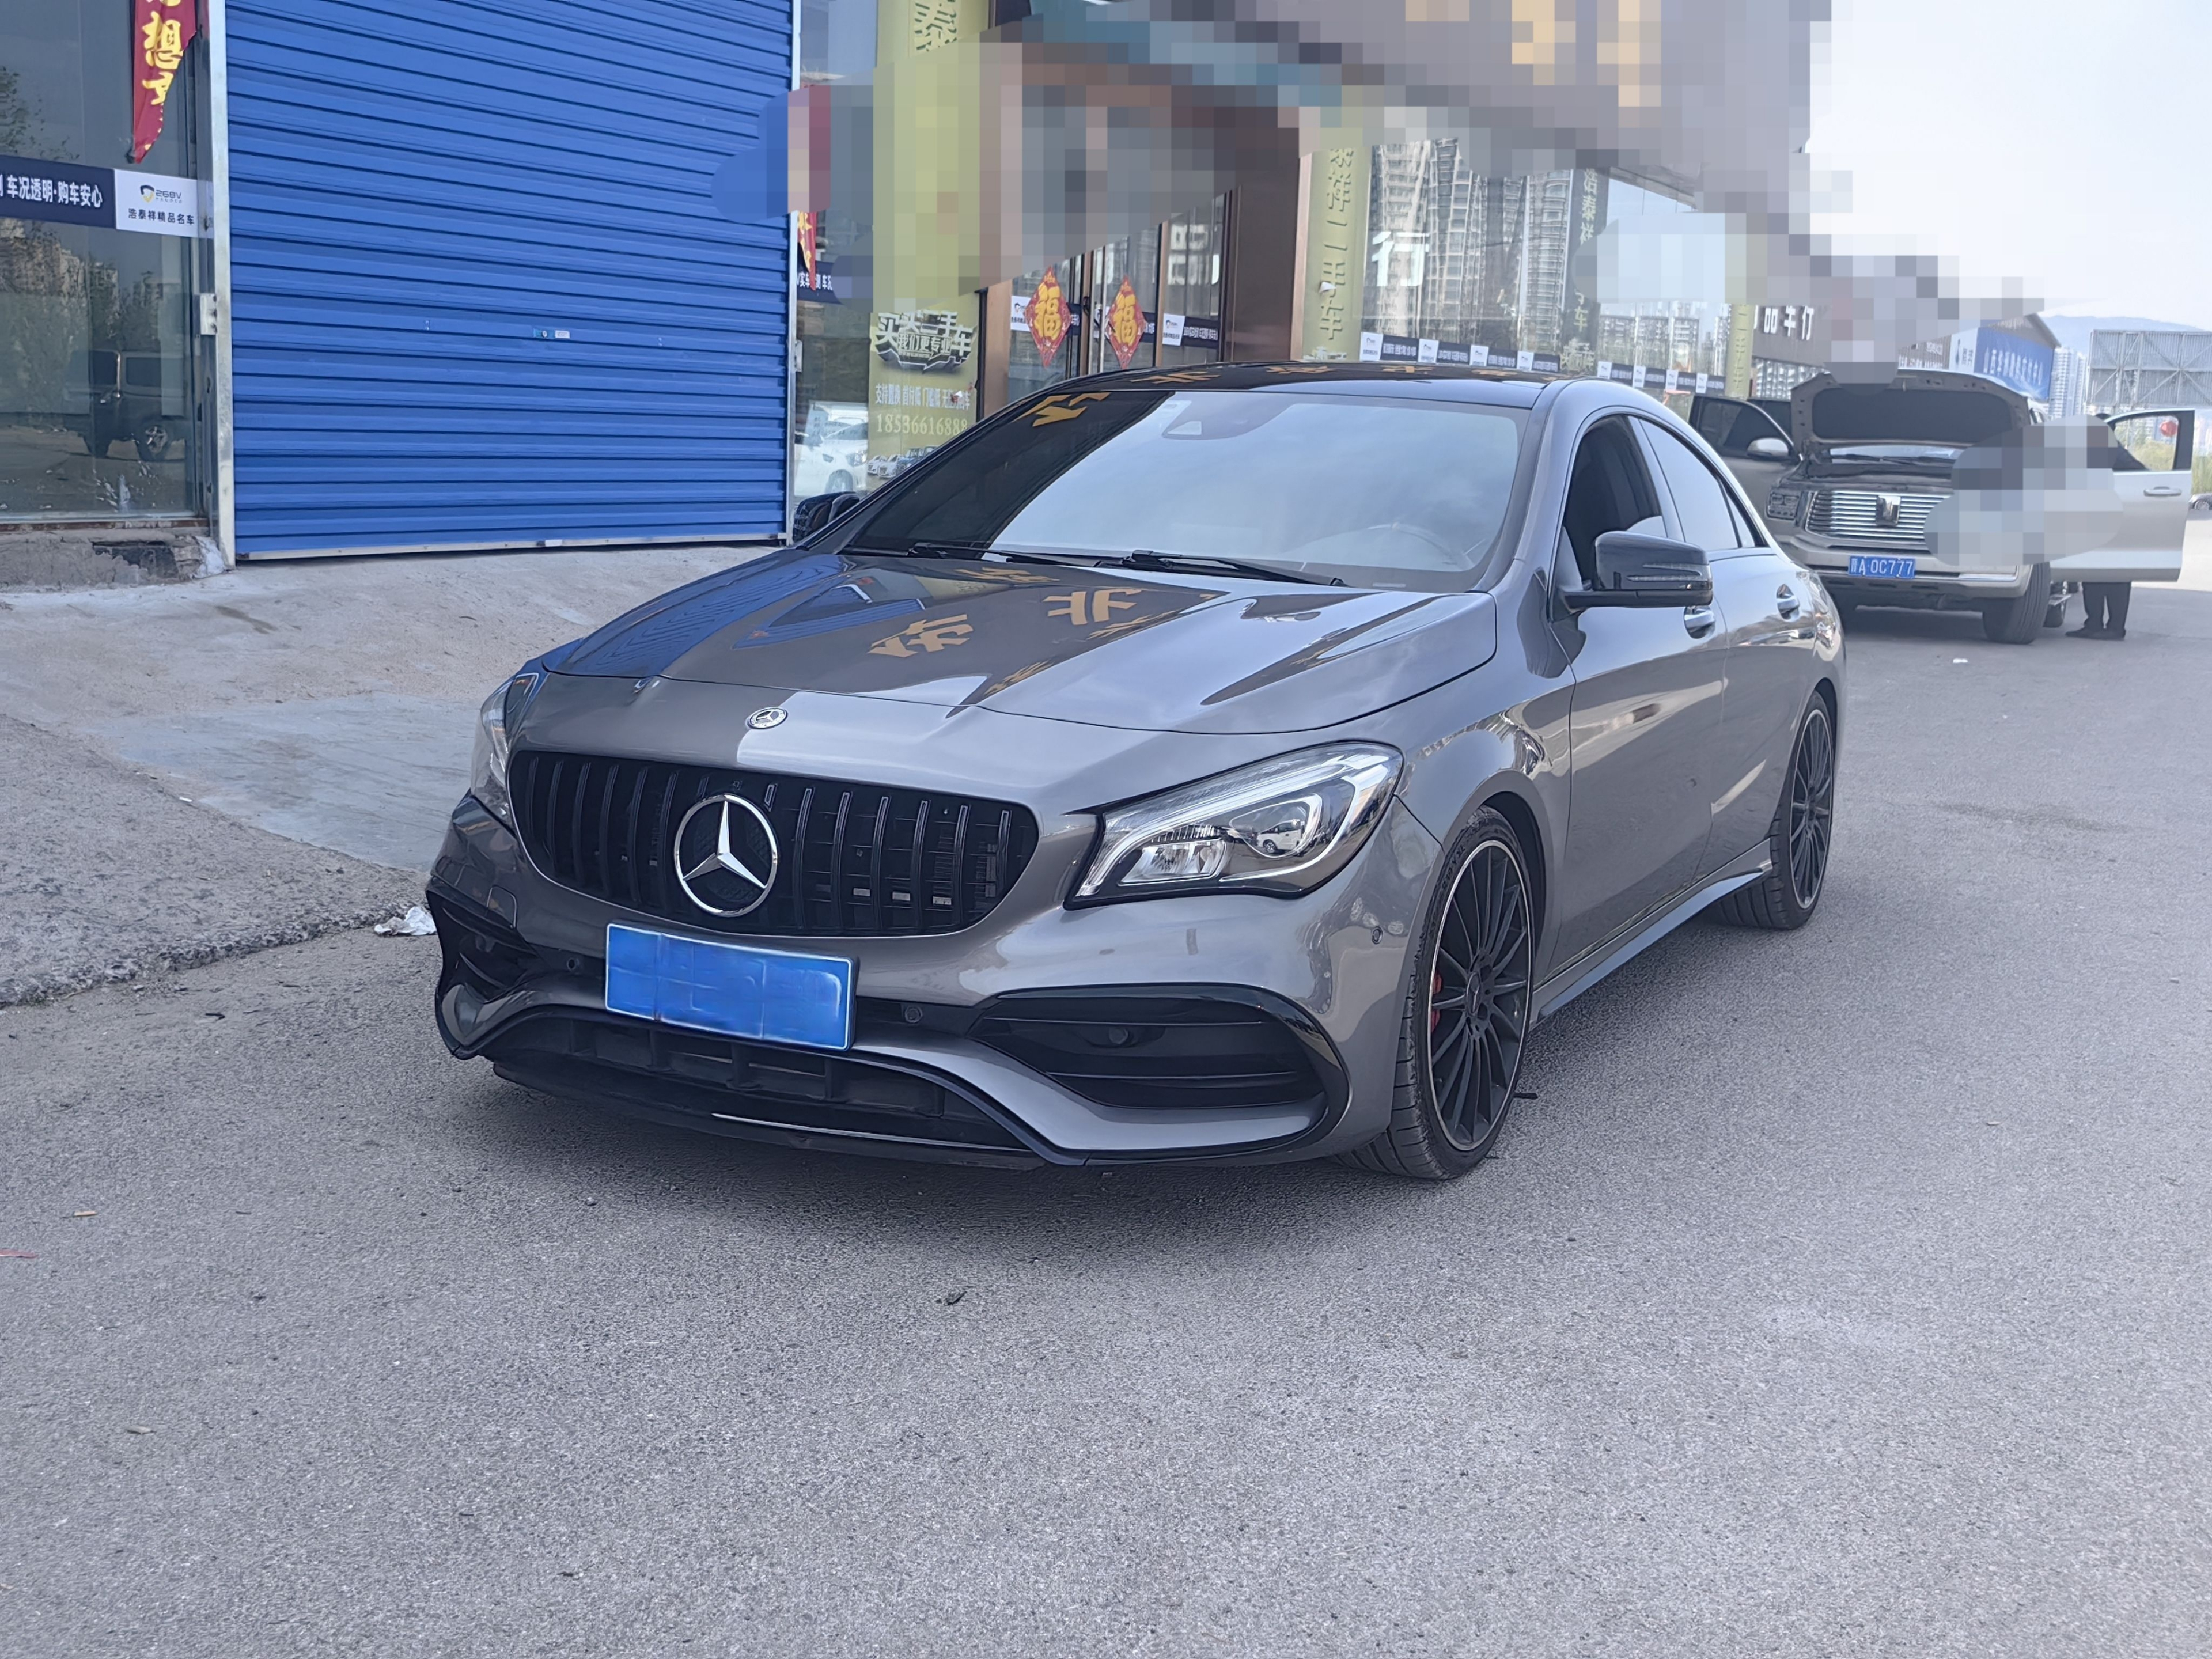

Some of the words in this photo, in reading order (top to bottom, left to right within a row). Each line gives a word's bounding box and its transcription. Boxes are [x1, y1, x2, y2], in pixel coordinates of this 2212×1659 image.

[1033, 282, 1062, 341] 福
[1113, 290, 1138, 347] 福
[897, 332, 952, 355] 我们更专业
